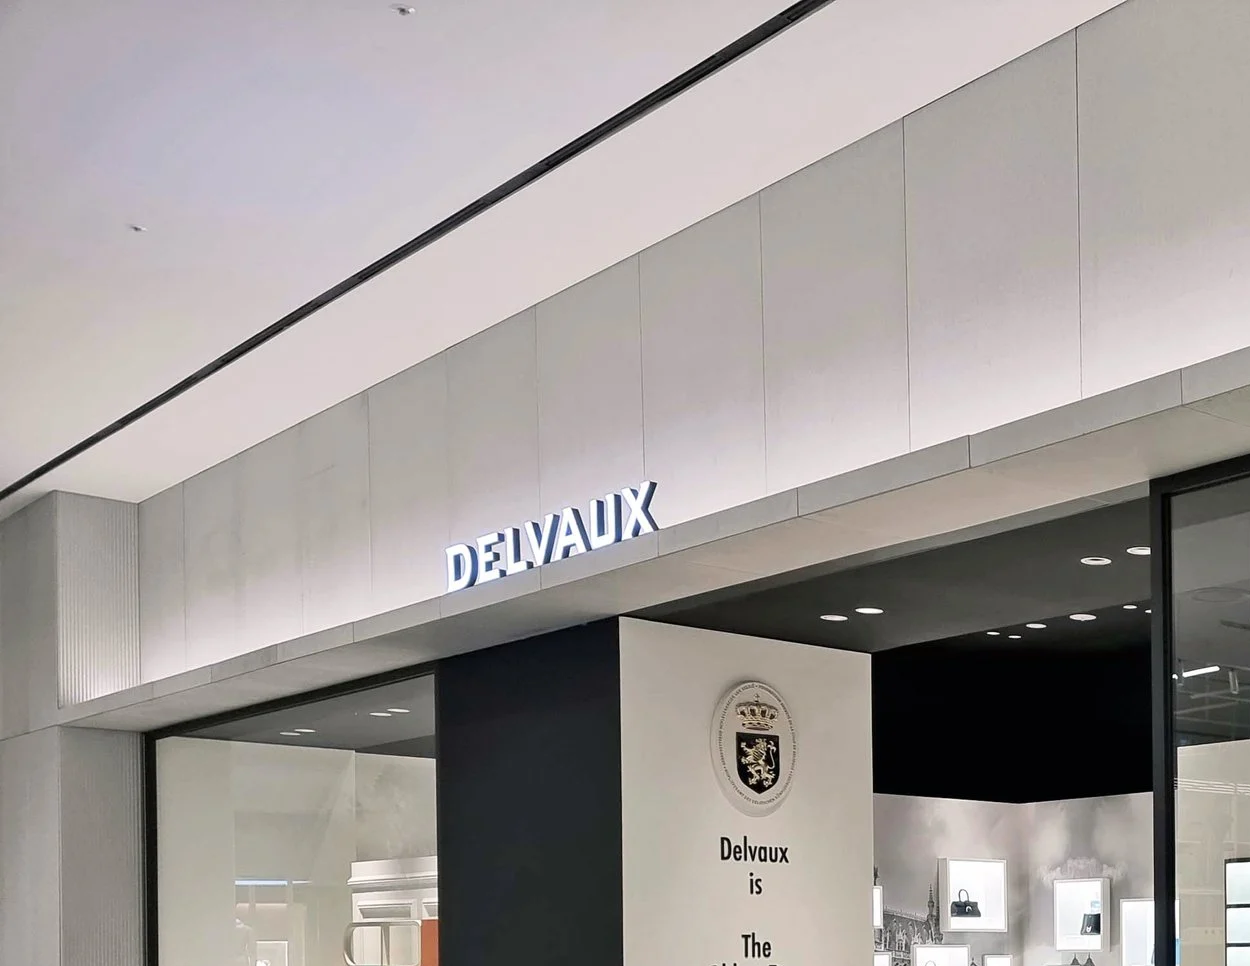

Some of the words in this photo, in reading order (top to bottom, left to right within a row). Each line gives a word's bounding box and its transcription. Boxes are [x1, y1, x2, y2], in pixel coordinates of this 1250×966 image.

[446, 480, 661, 593] DELVAUX
[720, 836, 789, 863] Delvaux
[749, 873, 763, 895] is
[741, 932, 772, 959] The
